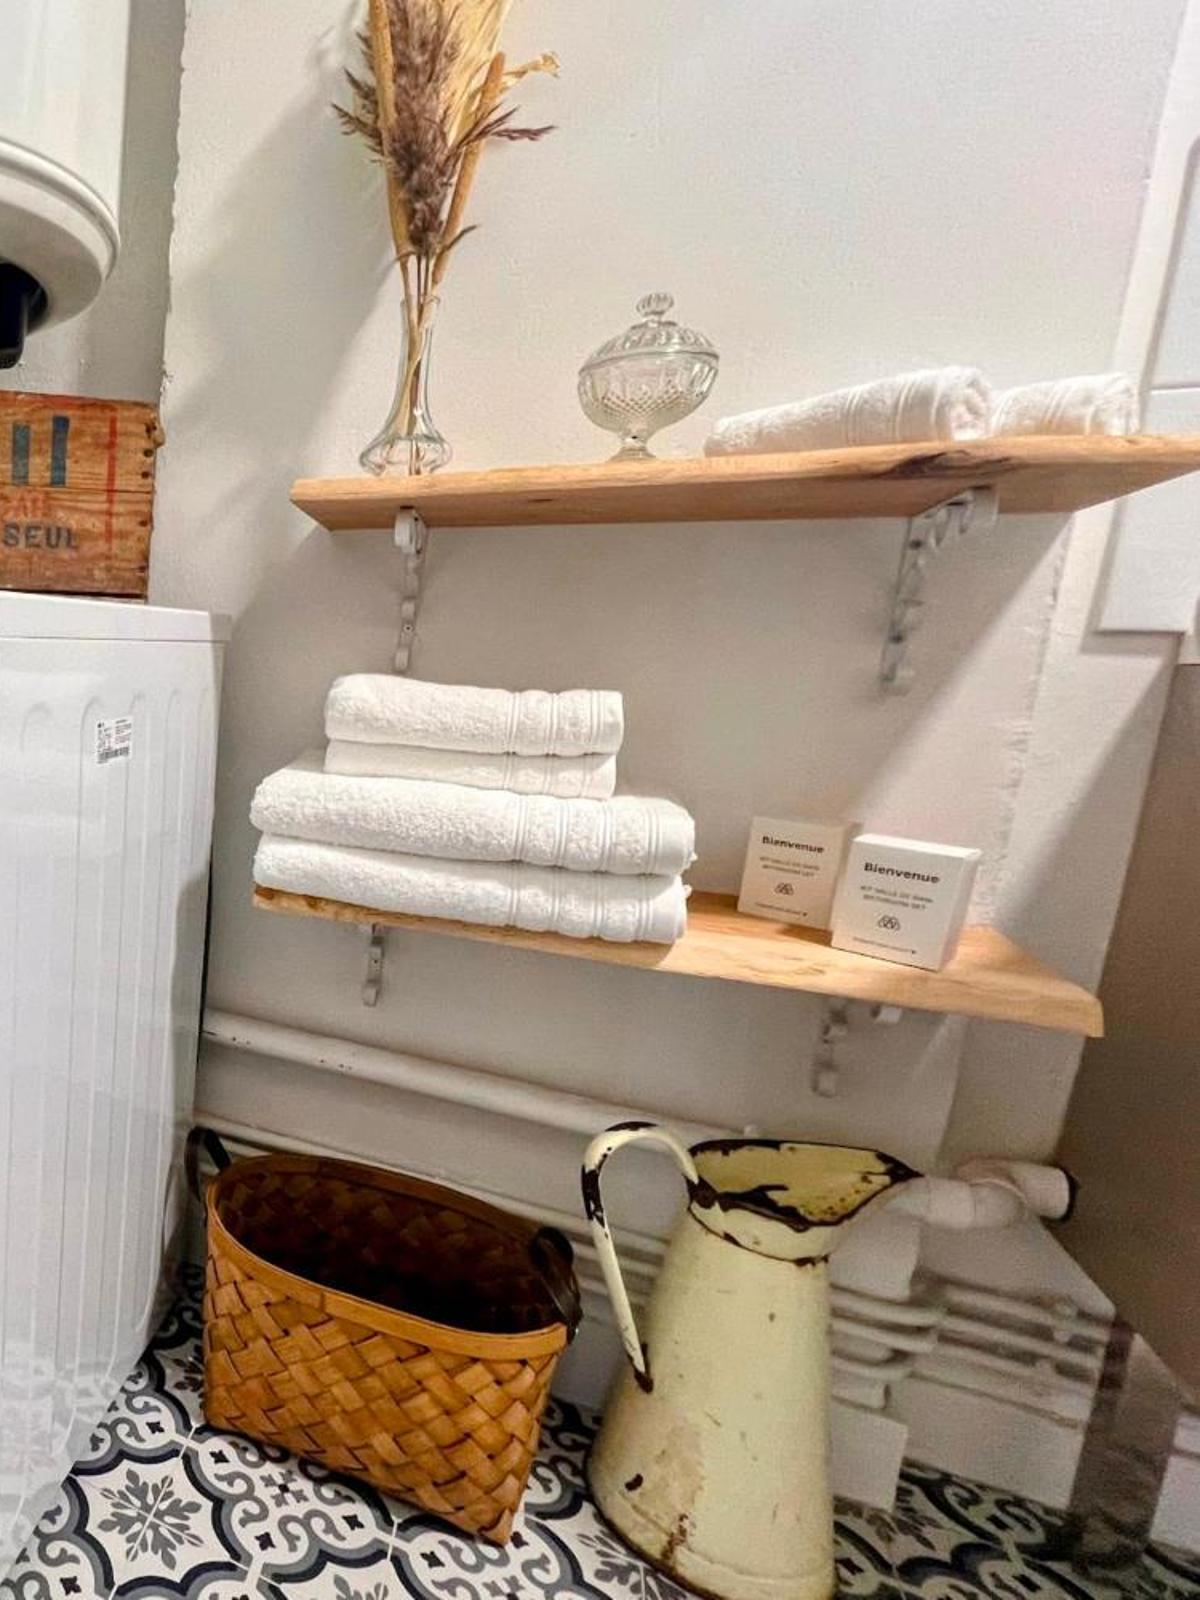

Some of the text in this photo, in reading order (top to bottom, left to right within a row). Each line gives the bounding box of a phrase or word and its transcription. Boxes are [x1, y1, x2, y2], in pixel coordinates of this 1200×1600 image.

[2, 523, 78, 550] SEUL
[762, 836, 824, 853] Bienvenue
[864, 862, 940, 883] Bienvenue
